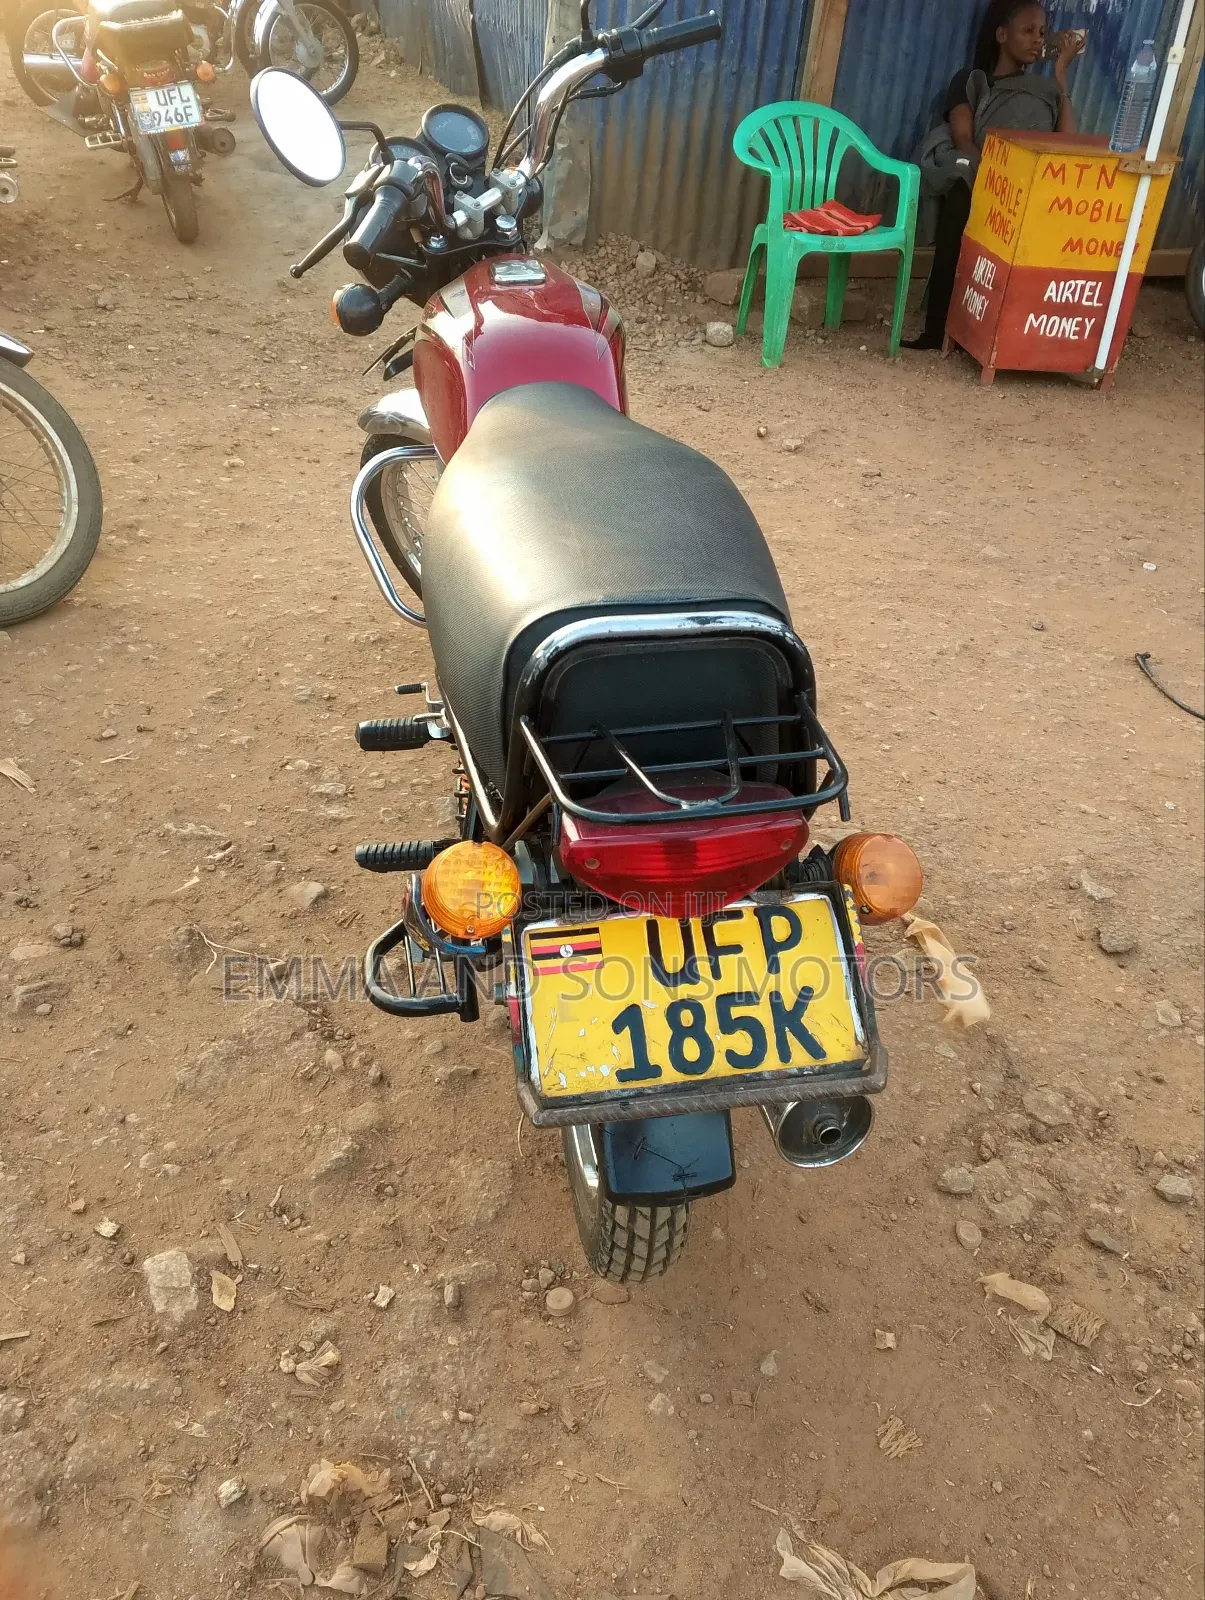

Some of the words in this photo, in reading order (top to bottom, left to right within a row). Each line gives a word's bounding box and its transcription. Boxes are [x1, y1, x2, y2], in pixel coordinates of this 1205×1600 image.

[154, 87, 191, 106] UFL
[151, 105, 193, 127] 946F
[983, 139, 1009, 167] MTN
[985, 166, 1023, 217] MOBILE
[1042, 161, 1120, 190] MTN
[985, 207, 1016, 246] MONEY
[1048, 196, 1147, 228] MOBIL
[972, 255, 997, 291] AIRTEL
[962, 284, 989, 322] MONEY
[1043, 280, 1103, 307] AIRTEL
[1024, 313, 1096, 340] MONEY
[647, 904, 802, 988] UFP
[612, 985, 827, 1083] 185K
